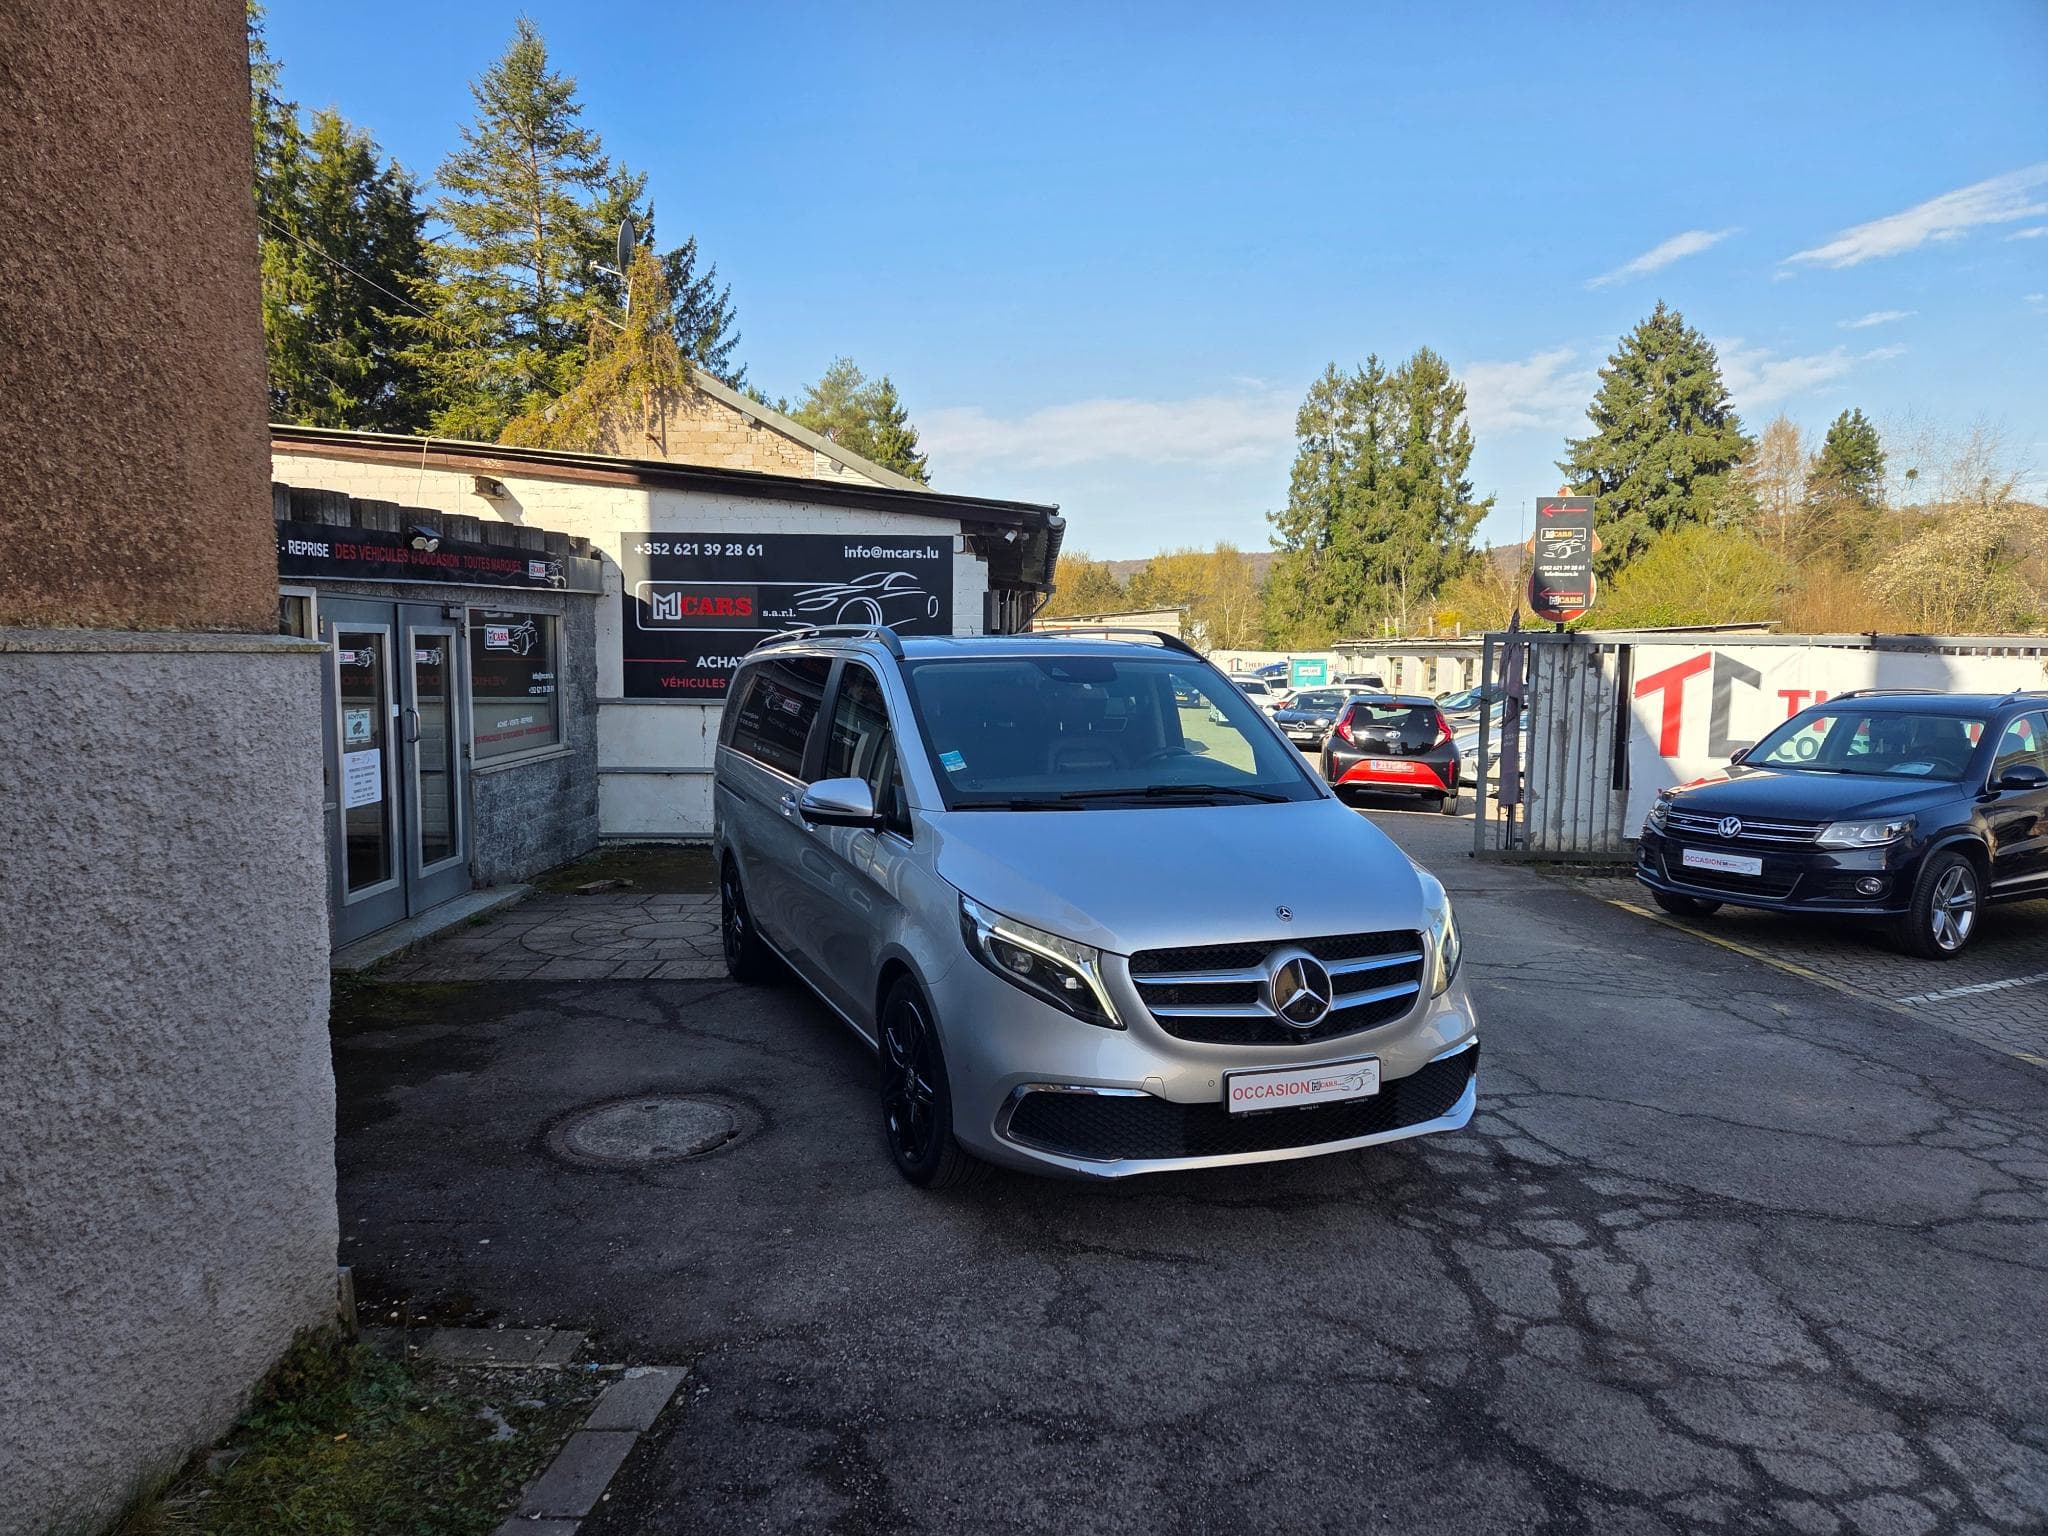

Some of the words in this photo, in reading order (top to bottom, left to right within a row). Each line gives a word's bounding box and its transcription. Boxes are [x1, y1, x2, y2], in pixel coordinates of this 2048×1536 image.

[287, 540, 330, 558] REPRISE
[335, 543, 356, 560] DES
[463, 555, 490, 570] TOUTES
[634, 543, 670, 555] +352
[673, 543, 699, 555] 621
[704, 544, 722, 556] 39
[725, 544, 743, 556] 28
[746, 544, 764, 557] 61
[844, 546, 939, 559] info@mcars.lu
[762, 608, 797, 617] s.a.r.l.
[661, 673, 726, 688] VÉHICULES
[1685, 855, 1721, 867] OCCASION
[1232, 1081, 1310, 1101] OCCASION
